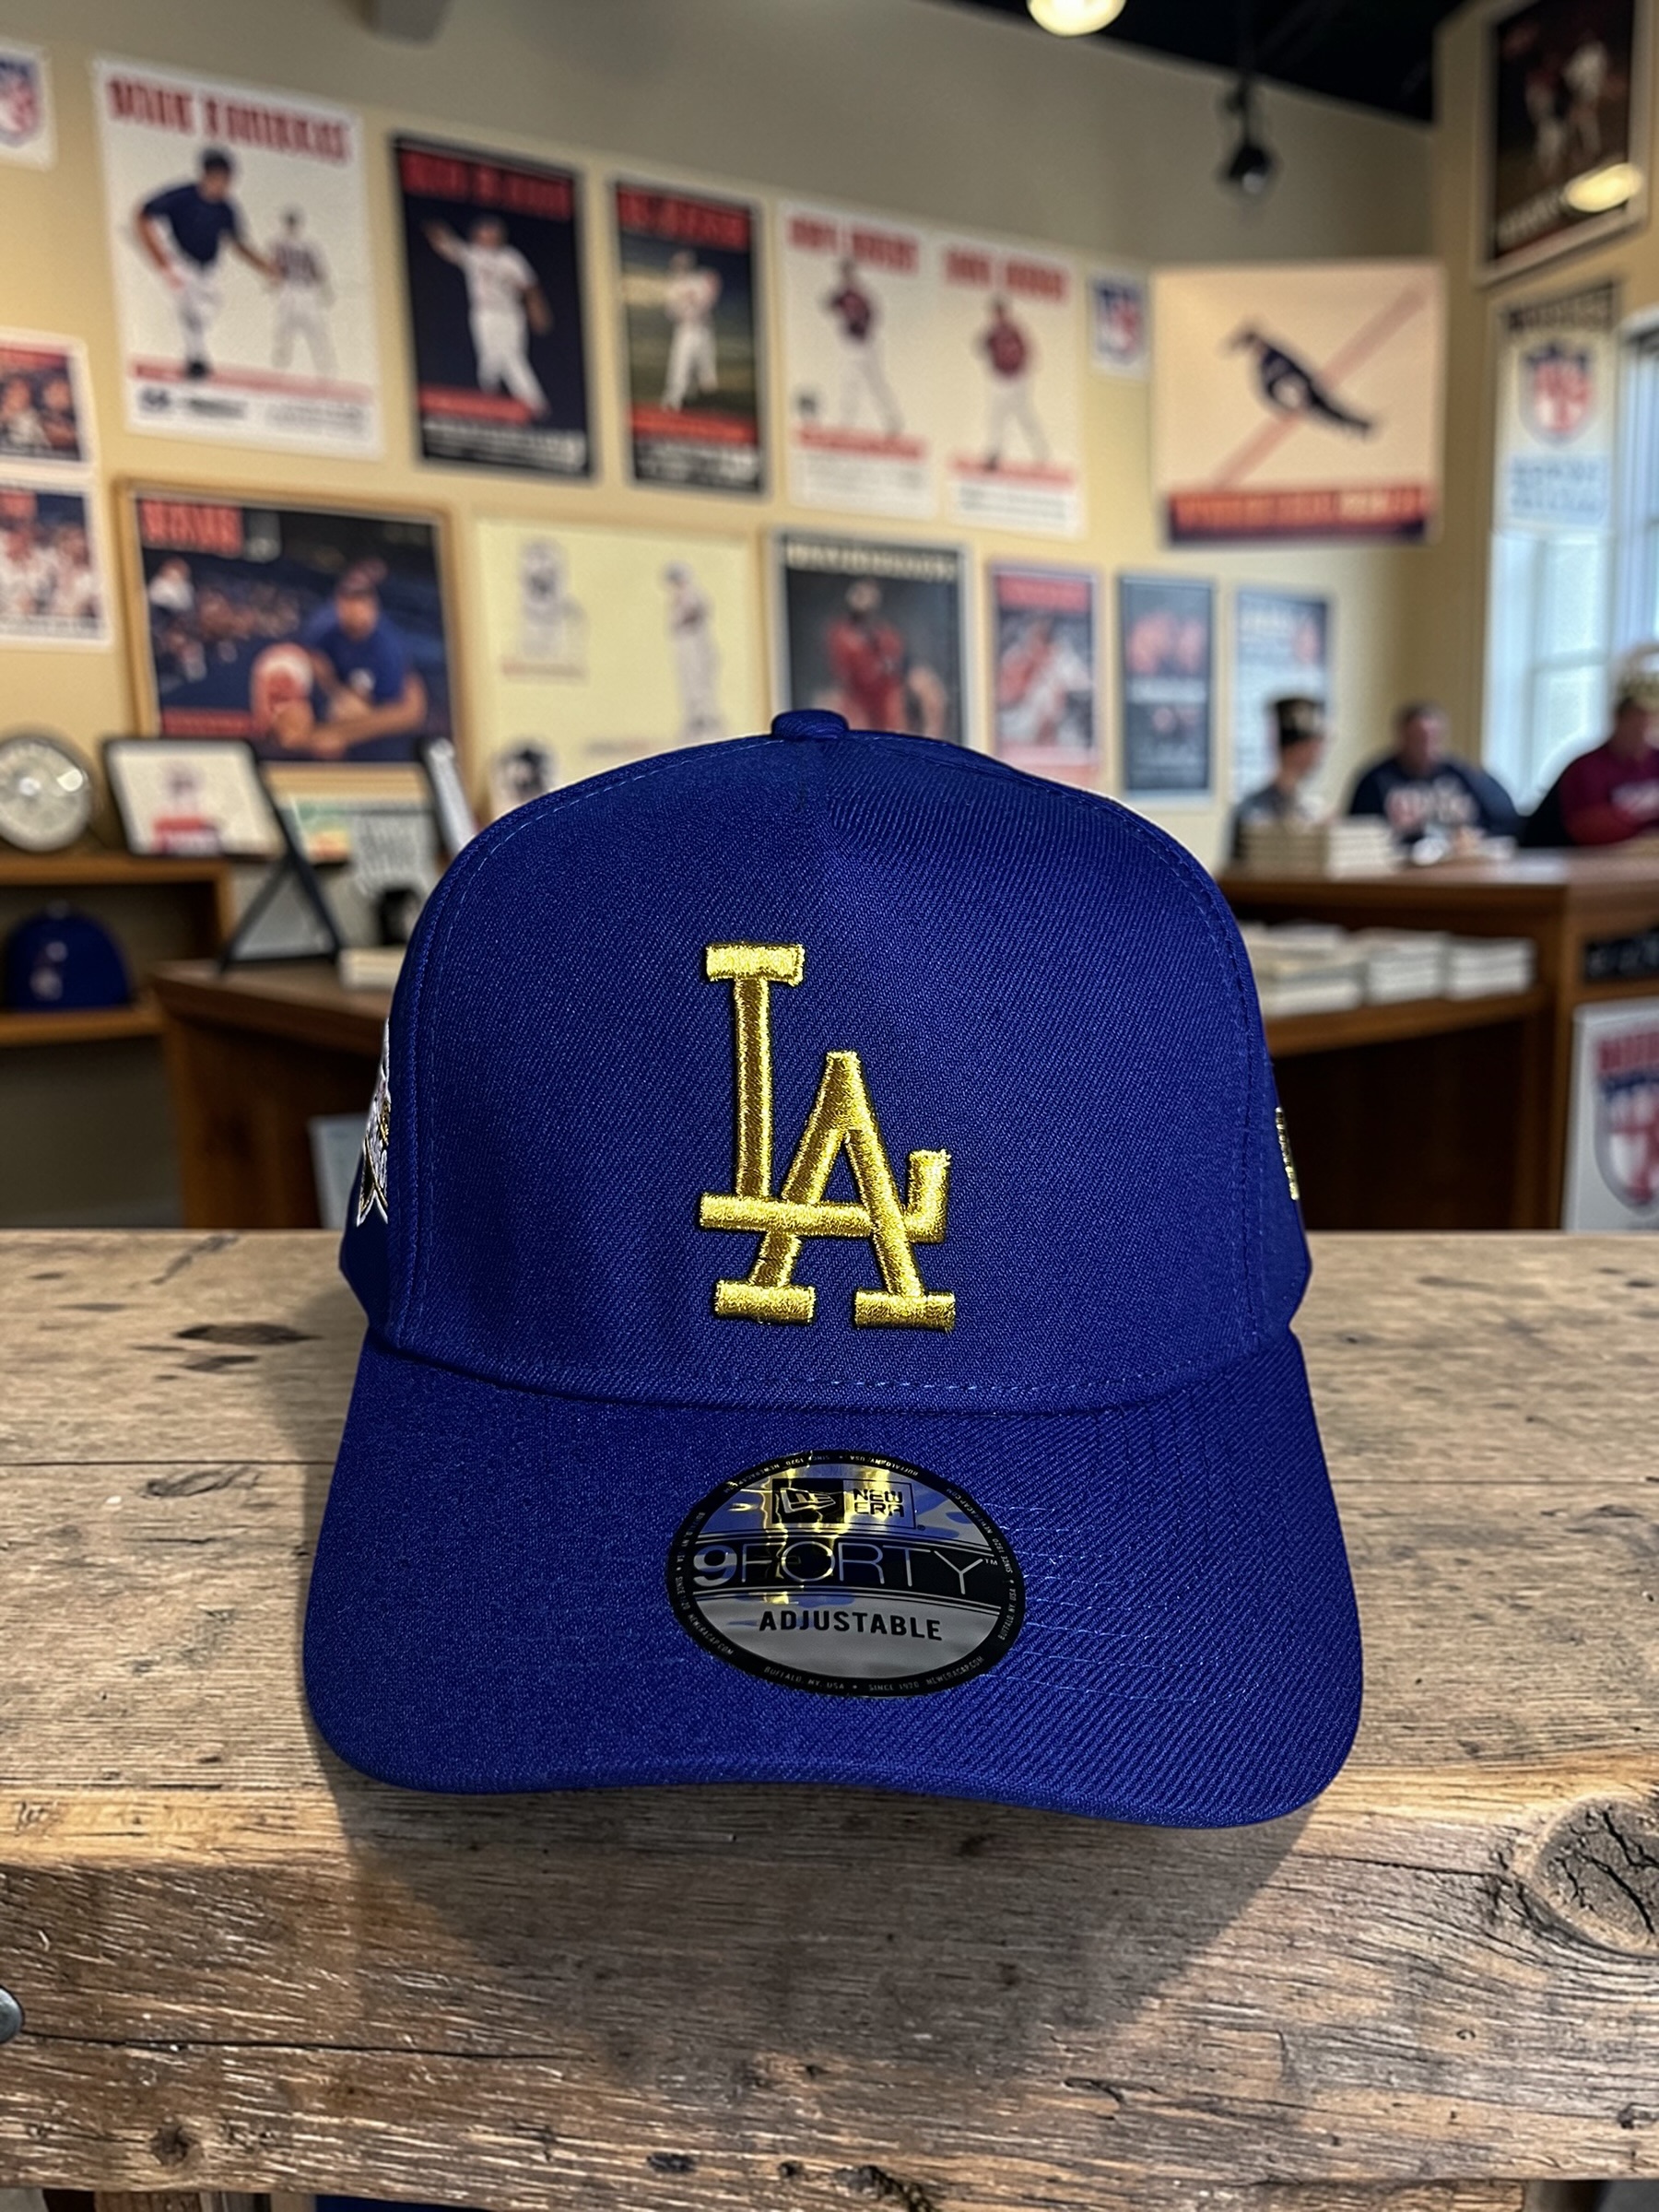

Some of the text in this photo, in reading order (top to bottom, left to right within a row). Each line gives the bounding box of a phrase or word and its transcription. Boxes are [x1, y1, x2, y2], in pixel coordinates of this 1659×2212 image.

[700, 942, 956, 1334] LA
[853, 1488, 903, 1503] NEW
[853, 1502, 905, 1518] ERA
[759, 1609, 943, 1641] ADJUSTABLE
